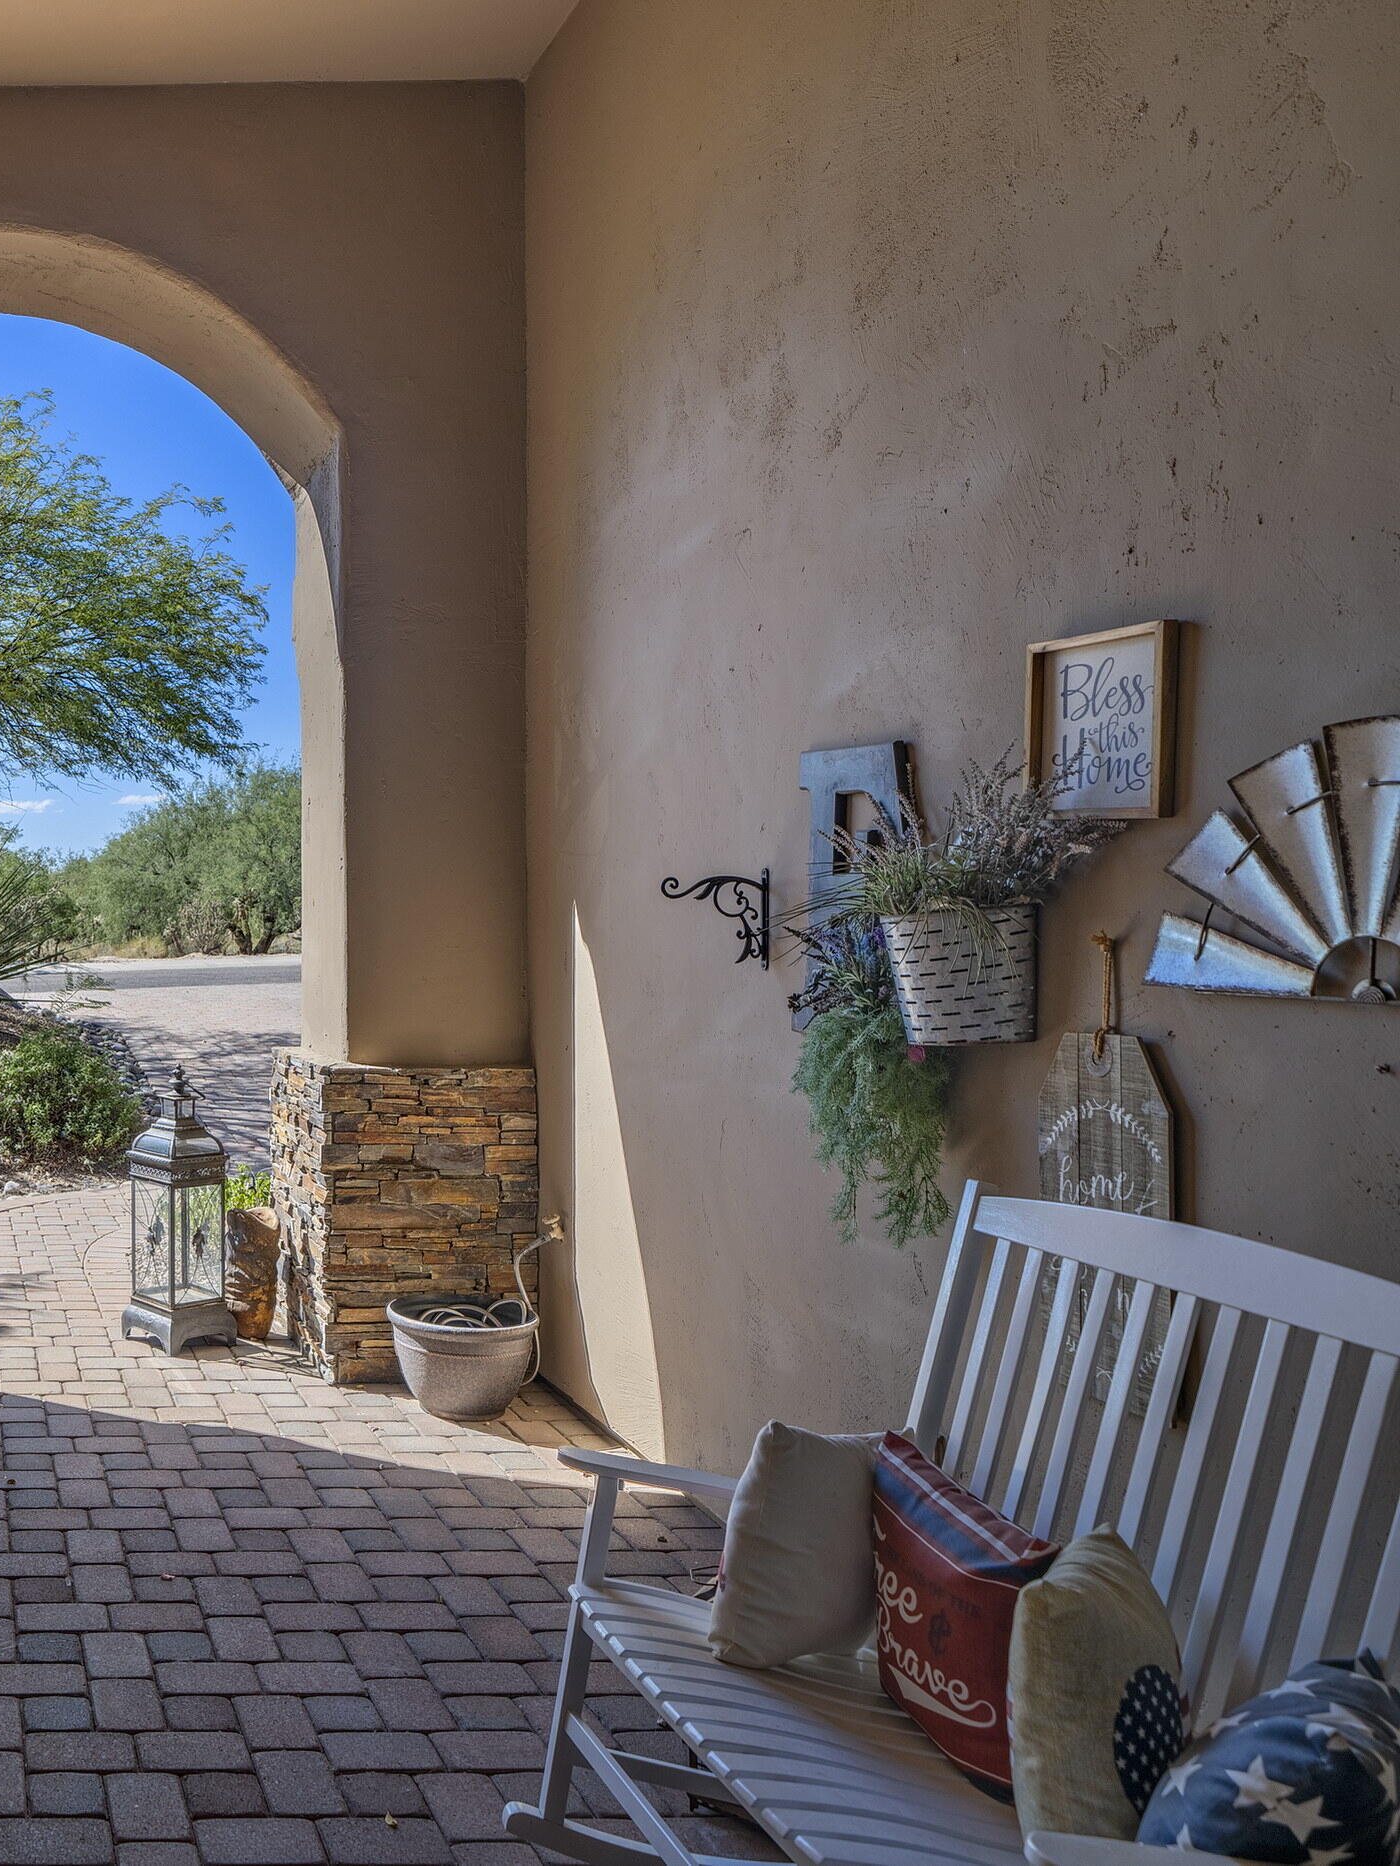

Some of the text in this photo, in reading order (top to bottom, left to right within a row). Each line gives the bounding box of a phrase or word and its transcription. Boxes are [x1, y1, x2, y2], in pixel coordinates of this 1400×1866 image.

[1059, 656, 1155, 722] Bless
[1051, 727, 1153, 794] Home
[1087, 712, 1145, 753] this
[1058, 1153, 1135, 1205] home
[873, 1551, 924, 1624] ree
[876, 1593, 974, 1712] Brave
